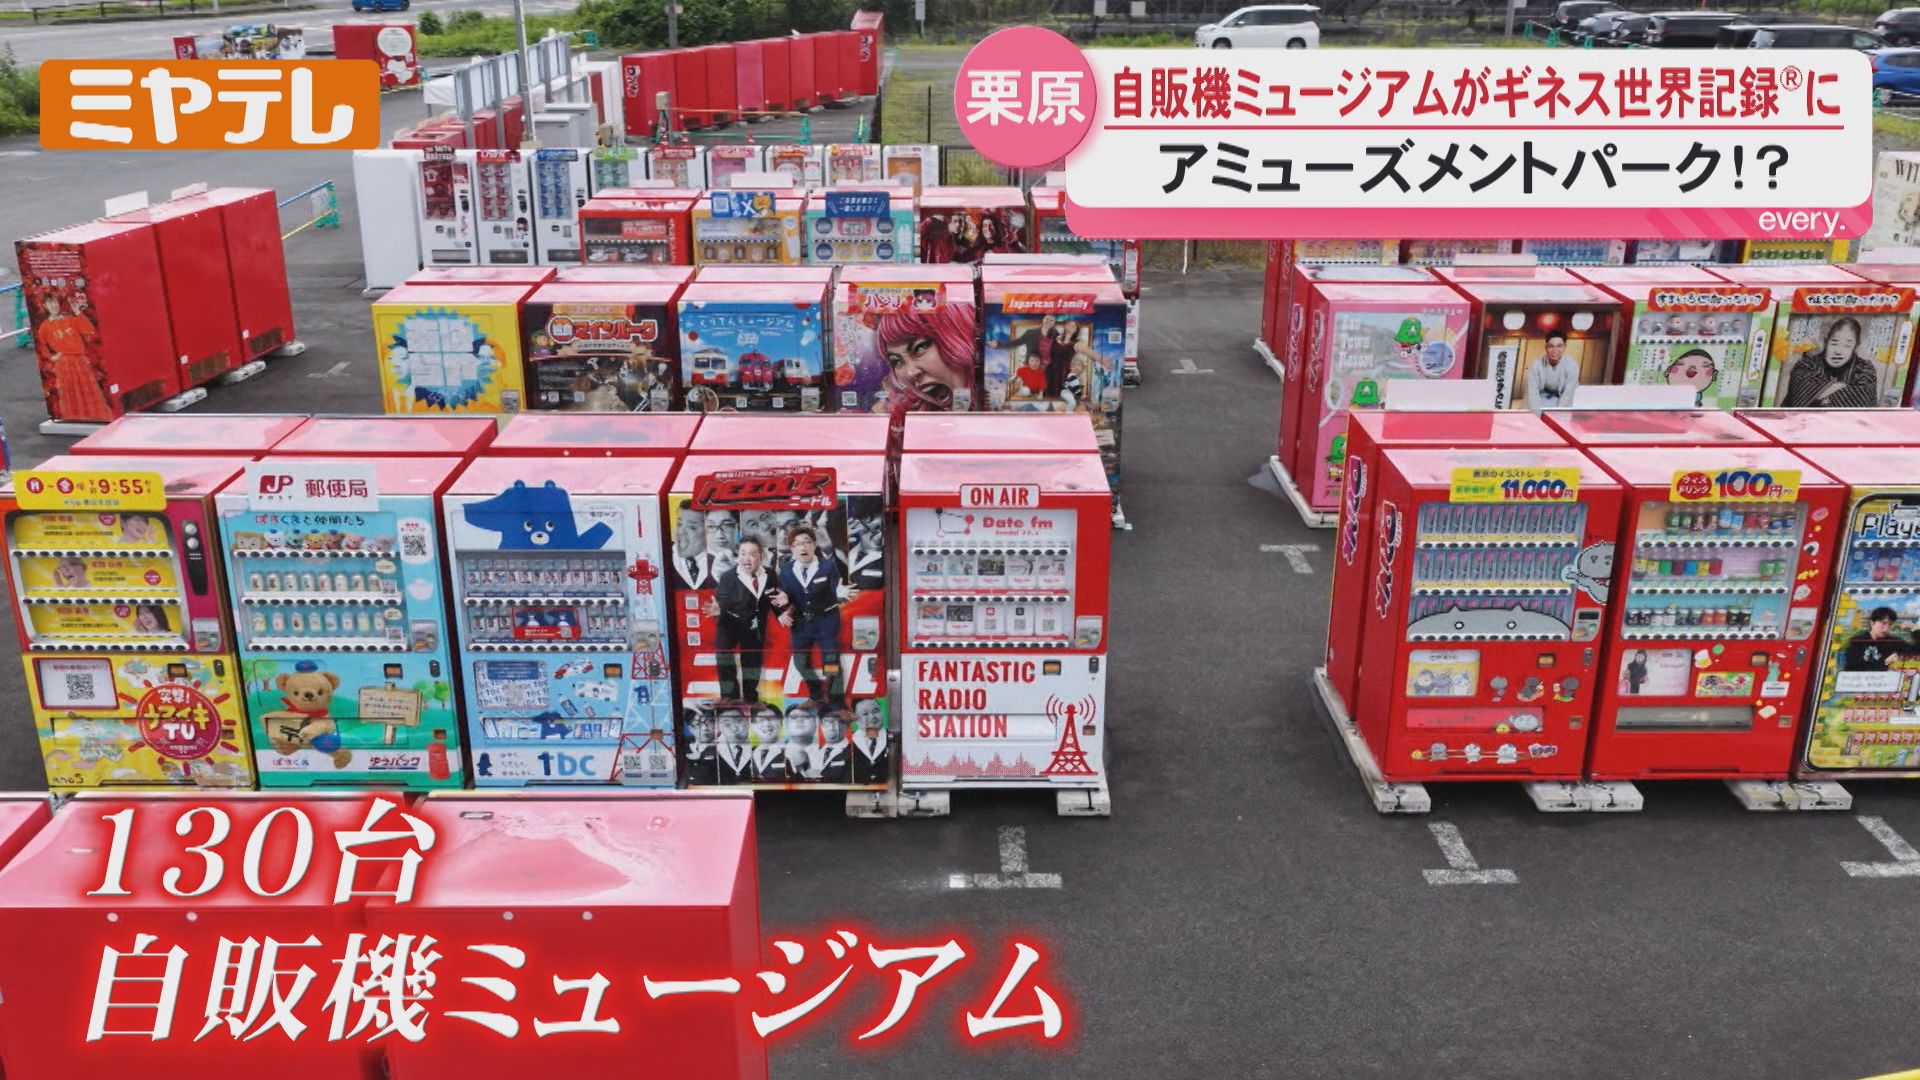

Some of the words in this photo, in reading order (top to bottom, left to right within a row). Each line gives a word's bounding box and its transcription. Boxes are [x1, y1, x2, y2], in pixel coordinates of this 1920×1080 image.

[304, 478, 368, 498] 郵便局
[970, 487, 998, 506] ON
[999, 487, 1029, 506] AIR
[982, 516, 1024, 529] Date
[1030, 514, 1054, 529] fm
[917, 660, 1036, 684] FANTASTIC
[917, 687, 987, 711] RADIO
[917, 715, 1008, 739] STATION
